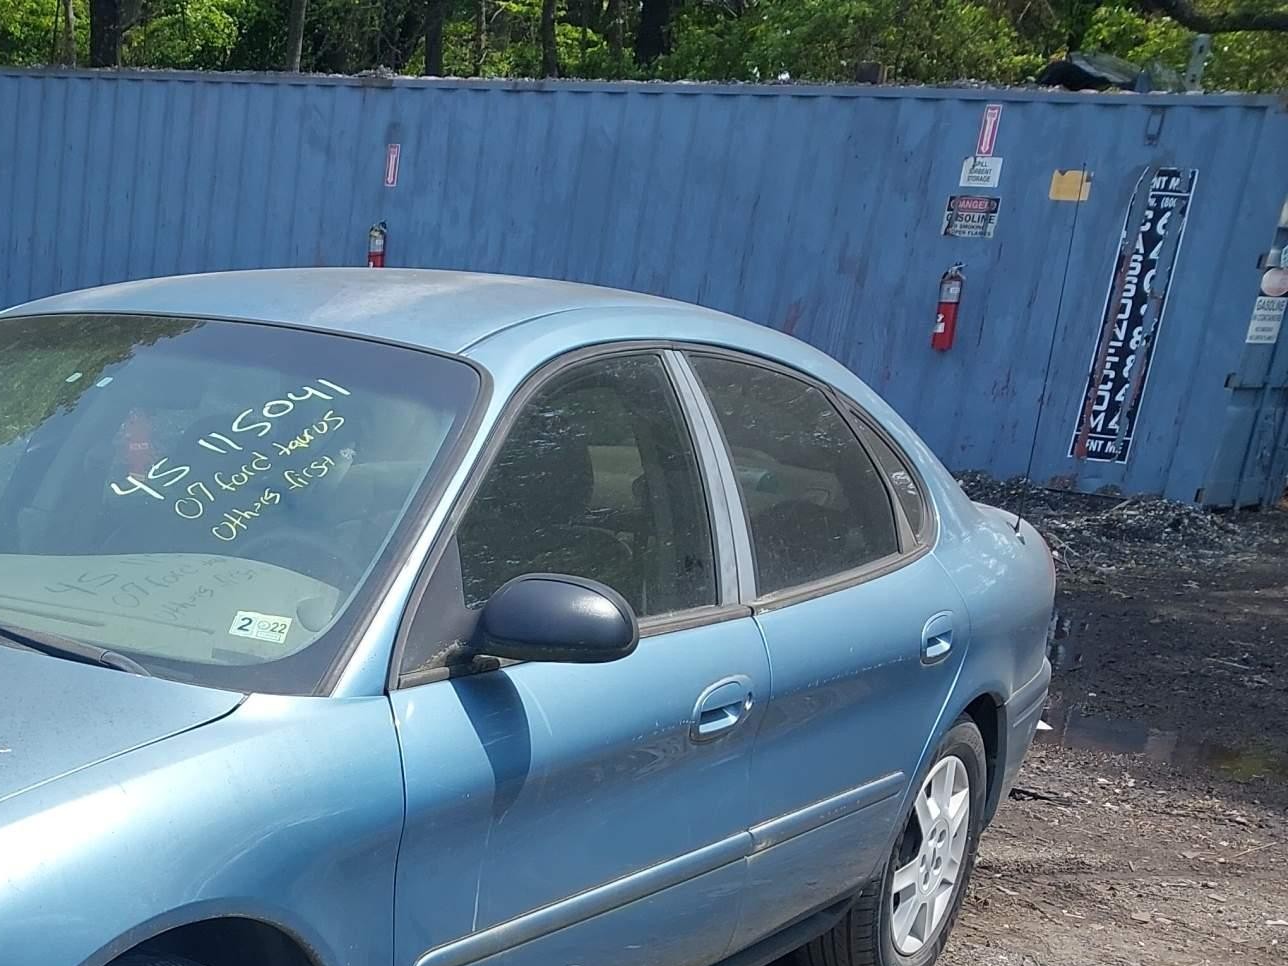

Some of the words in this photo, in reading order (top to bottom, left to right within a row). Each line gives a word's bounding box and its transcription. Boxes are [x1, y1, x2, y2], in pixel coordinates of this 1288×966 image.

[175, 482, 215, 519] 07
[237, 617, 253, 631] 2
[270, 622, 287, 634] 22
